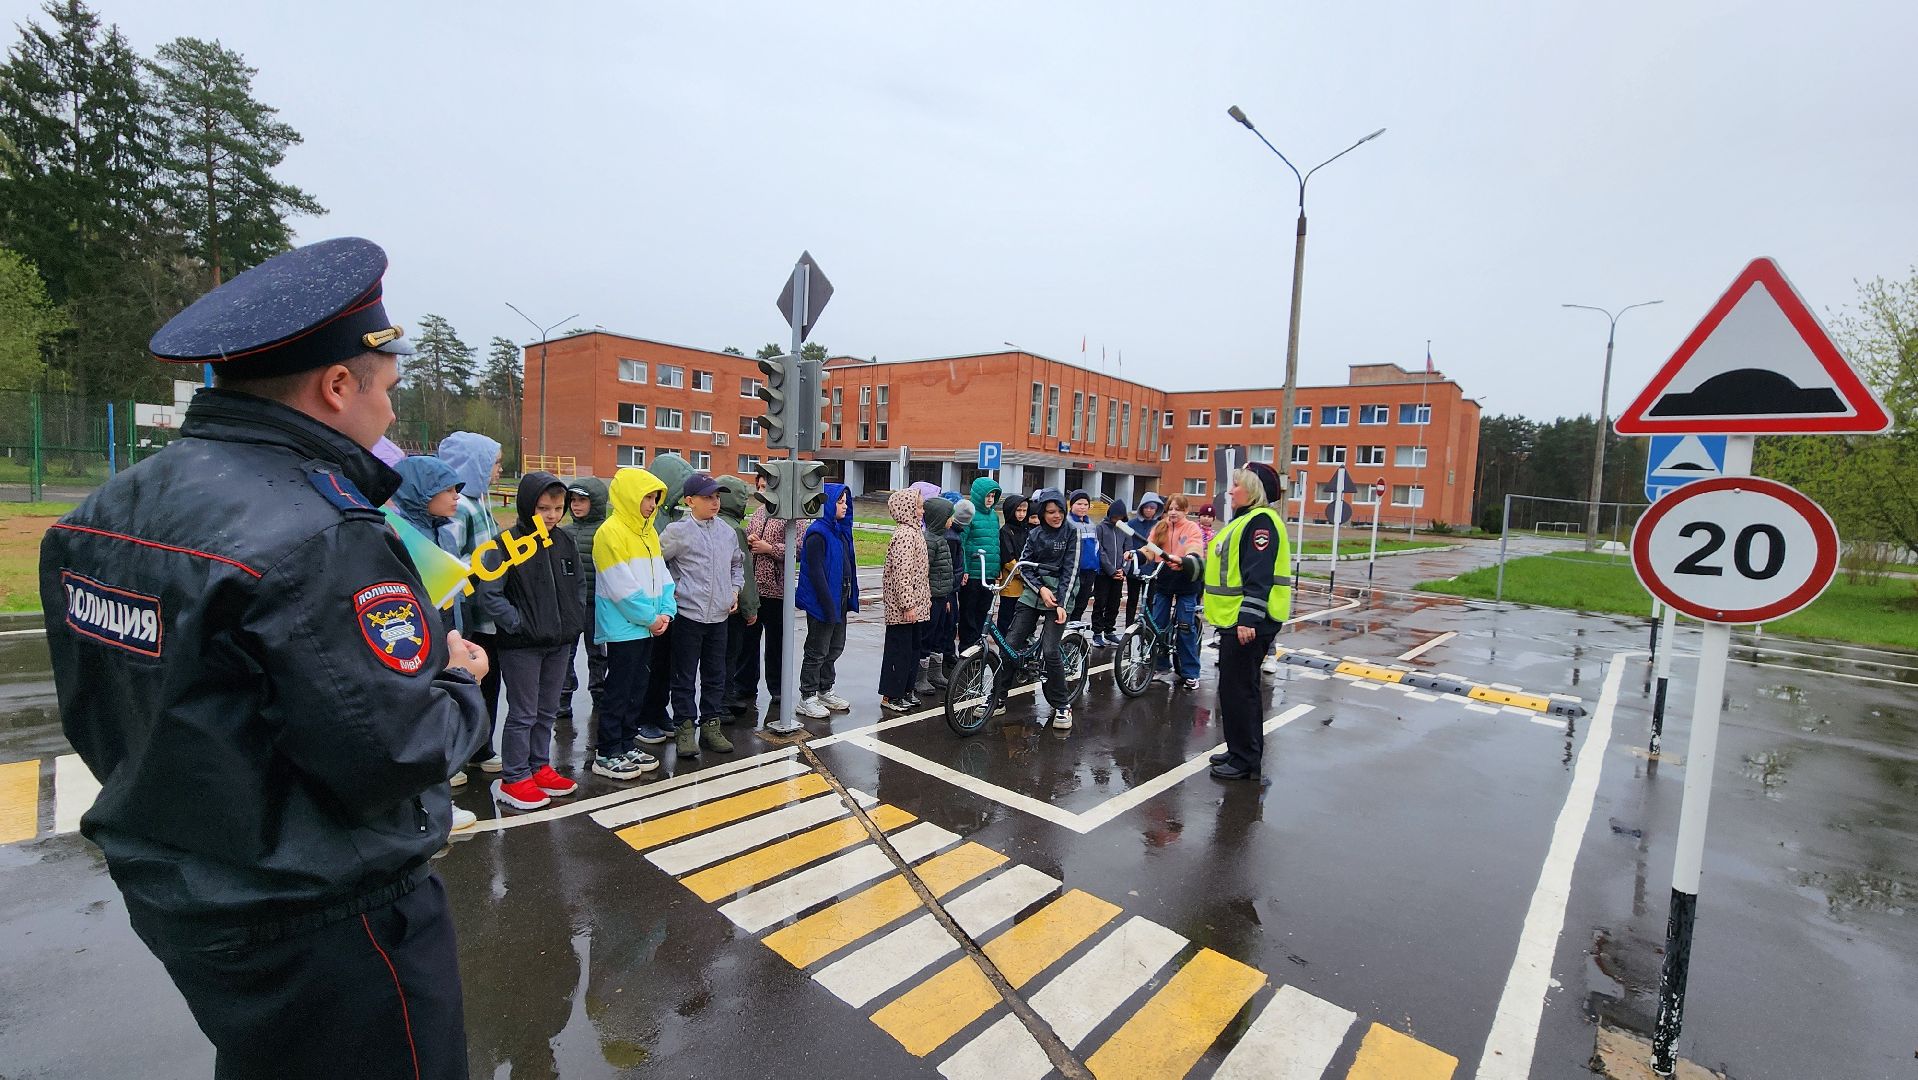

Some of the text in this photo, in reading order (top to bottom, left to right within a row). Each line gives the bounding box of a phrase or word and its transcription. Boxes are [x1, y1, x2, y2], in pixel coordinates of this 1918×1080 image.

[984, 445, 998, 466] P
[442, 513, 553, 611] СЬ!
[1673, 521, 1786, 580] 20
[358, 585, 409, 605] ПОЛИЦИЯ
[65, 583, 158, 643] ПОЛИЦИЯ
[990, 625, 1018, 659] FORWARD
[399, 655, 422, 670] МВД
